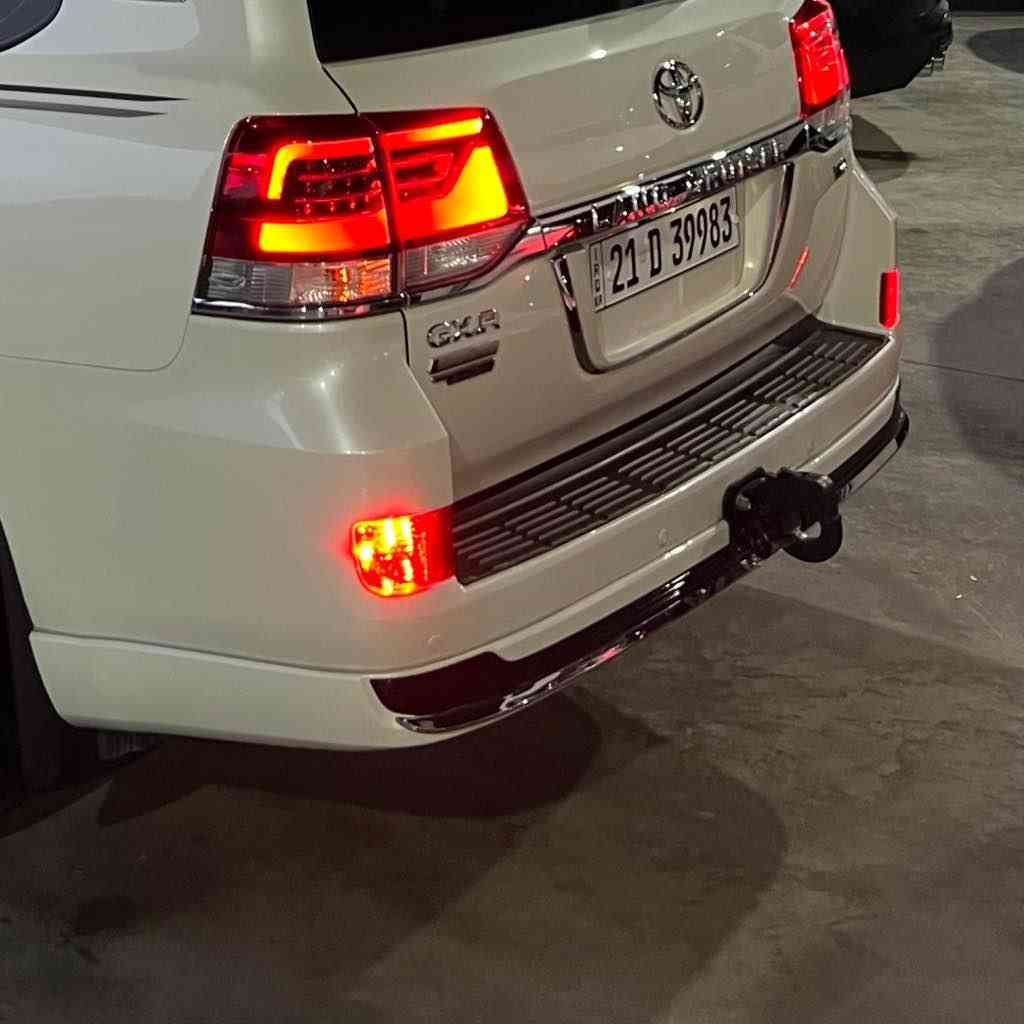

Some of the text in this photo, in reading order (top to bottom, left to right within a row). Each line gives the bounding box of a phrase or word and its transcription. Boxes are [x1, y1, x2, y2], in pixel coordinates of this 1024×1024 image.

[610, 196, 732, 294] 21 D 39983
[427, 308, 500, 348] GXR
